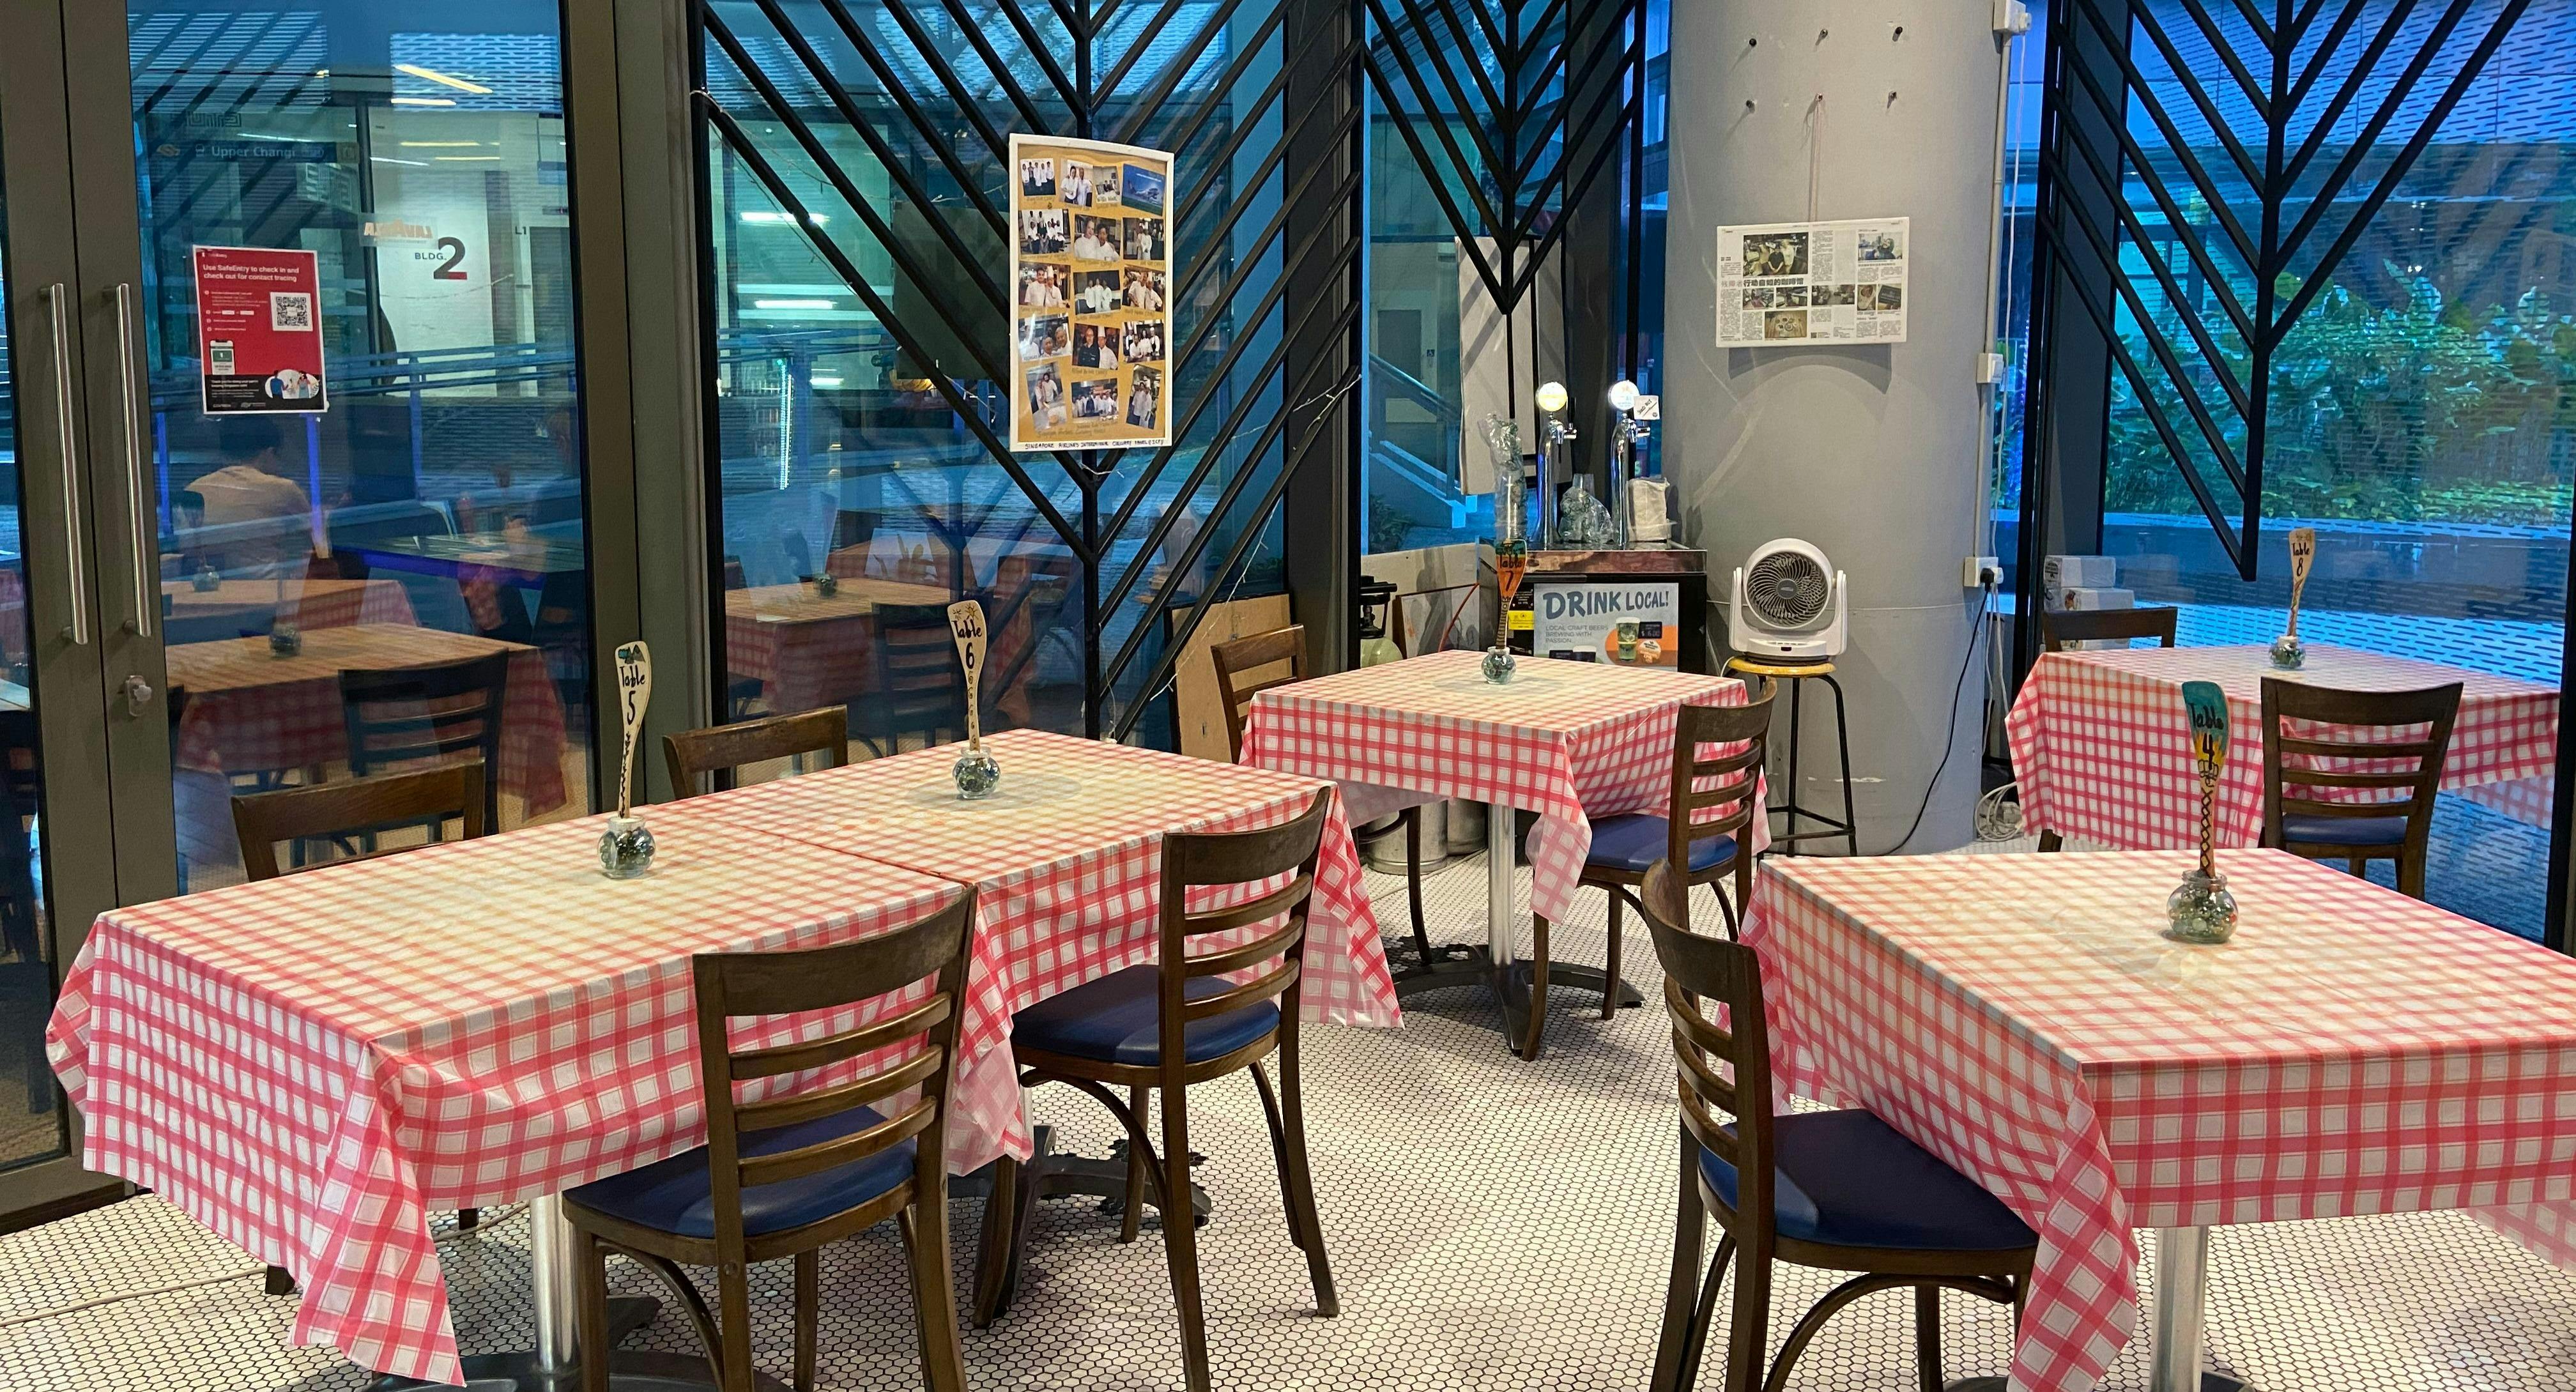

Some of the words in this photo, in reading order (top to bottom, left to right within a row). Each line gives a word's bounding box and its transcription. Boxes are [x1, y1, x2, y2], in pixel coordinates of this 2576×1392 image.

[211, 146, 248, 158] Upper
[515, 226, 527, 235] L1
[217, 264, 249, 273] SafeEntry
[433, 236, 468, 280] 2
[2292, 543, 2310, 556] Table
[2297, 558, 2303, 576] 8
[1505, 570, 1514, 592] 7
[1543, 591, 1621, 620] DRINK
[1625, 591, 1669, 611] LOCAL!
[951, 619, 982, 639] Table
[966, 642, 974, 669] 6
[620, 664, 645, 688] Table
[627, 691, 636, 725] 5
[2188, 703, 2224, 730] Table
[2203, 733, 2214, 770] 4
